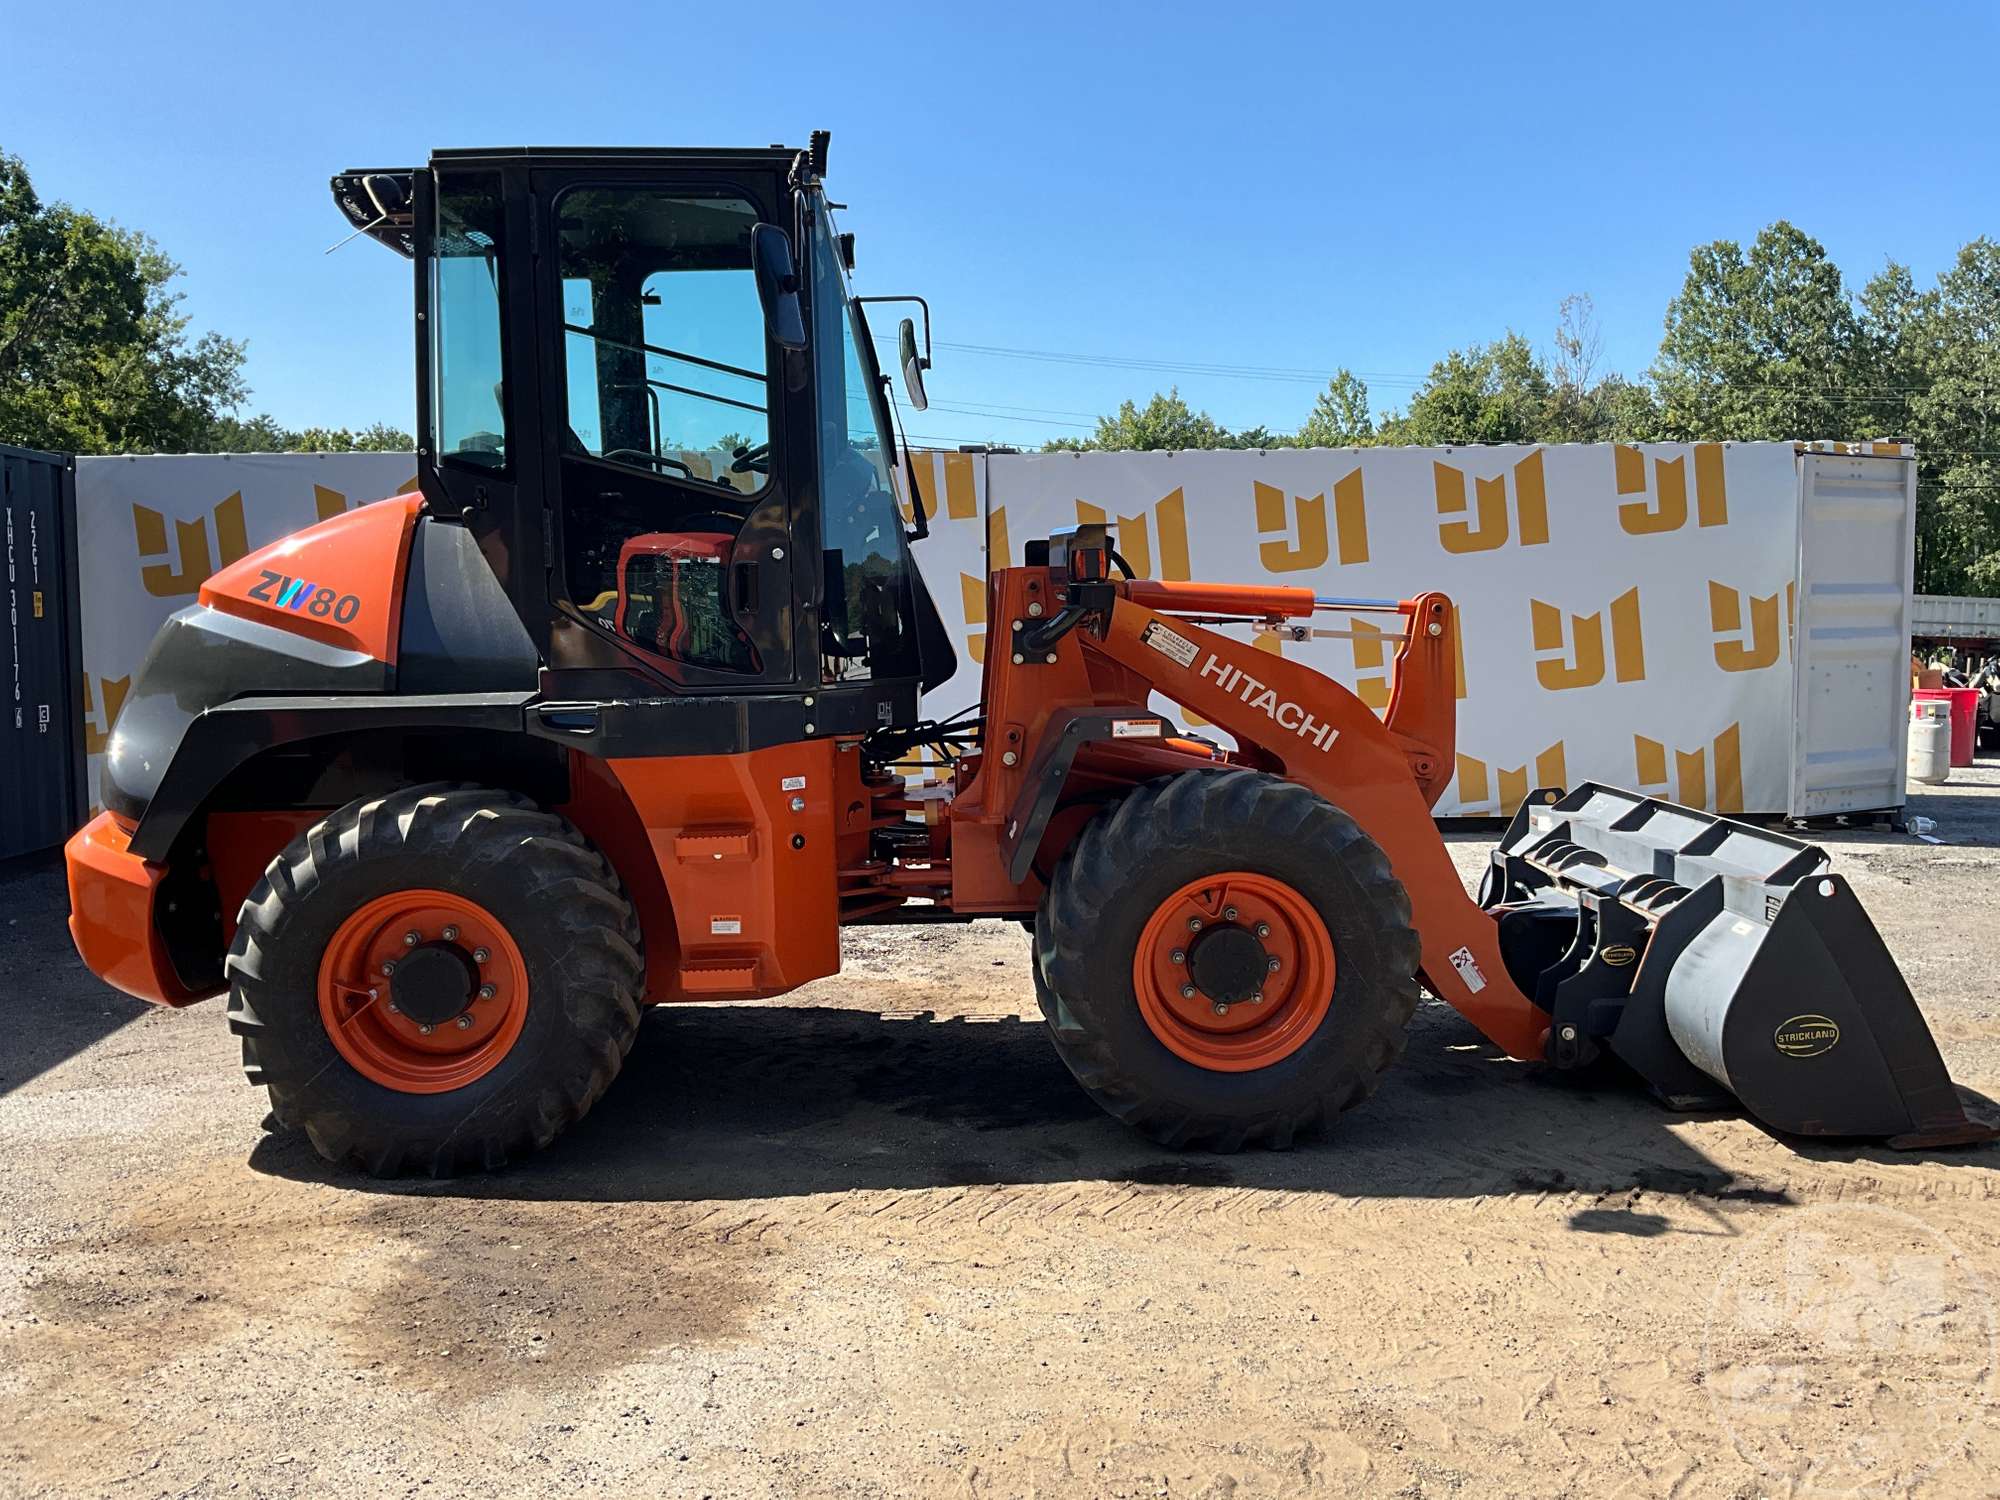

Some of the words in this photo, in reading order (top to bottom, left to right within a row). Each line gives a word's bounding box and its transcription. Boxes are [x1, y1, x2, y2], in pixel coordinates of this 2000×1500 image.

[6, 507, 15, 583] XHCU
[30, 510, 38, 584] 22G1
[247, 569, 360, 624] ZW80
[10, 589, 20, 701] 301176
[1200, 653, 1340, 752] HITACHI
[1778, 1029, 1836, 1043] STRICKLAND
